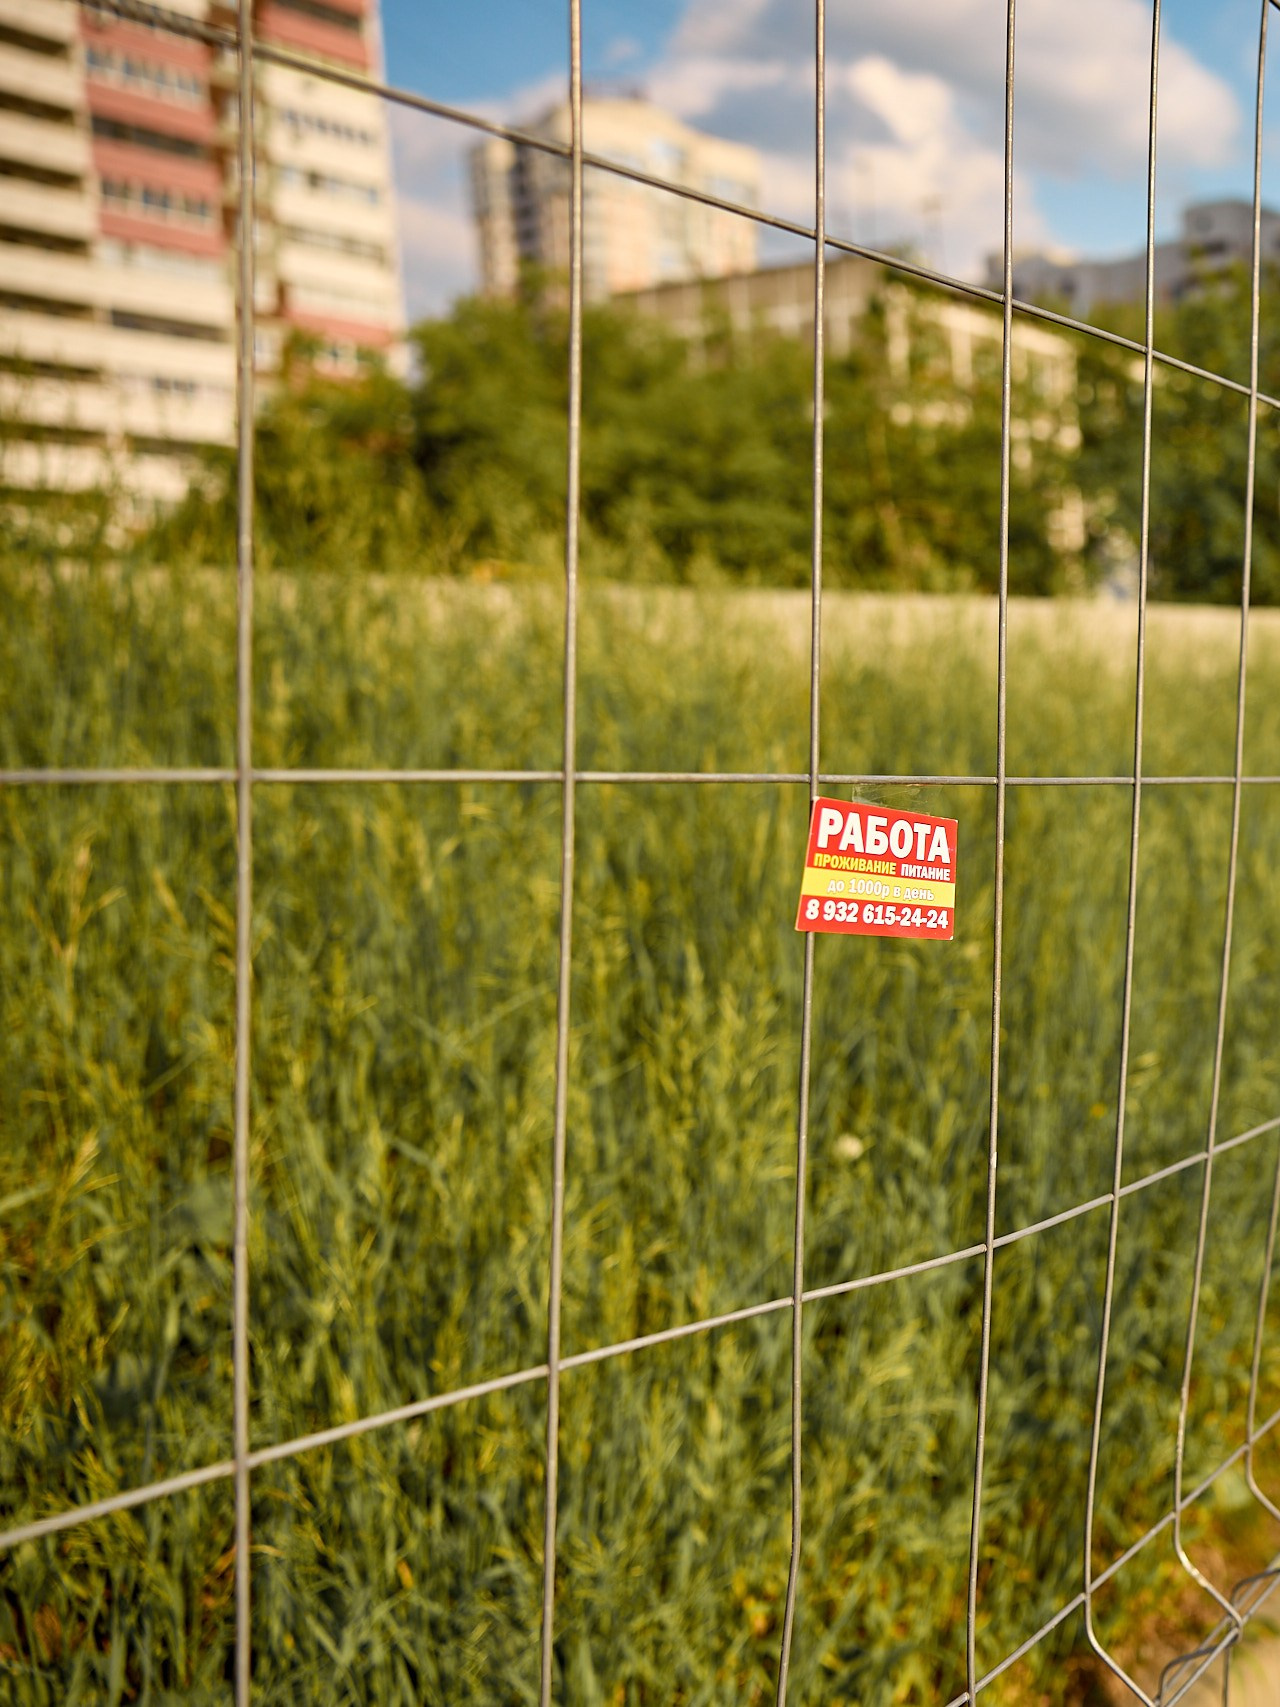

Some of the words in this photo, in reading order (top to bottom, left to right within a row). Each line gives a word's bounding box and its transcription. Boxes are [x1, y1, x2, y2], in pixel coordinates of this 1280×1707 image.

[817, 807, 951, 864] РАБОТА
[813, 853, 896, 875] ПРОЖИВАНИЕ
[901, 863, 950, 881] ПИТАНИЕ
[827, 879, 845, 893] до
[848, 878, 890, 899] 1000р
[893, 886, 901, 898] в
[903, 886, 935, 901] день
[805, 898, 819, 920] 8
[823, 900, 859, 923] 932
[862, 903, 949, 929] 615-24-24
